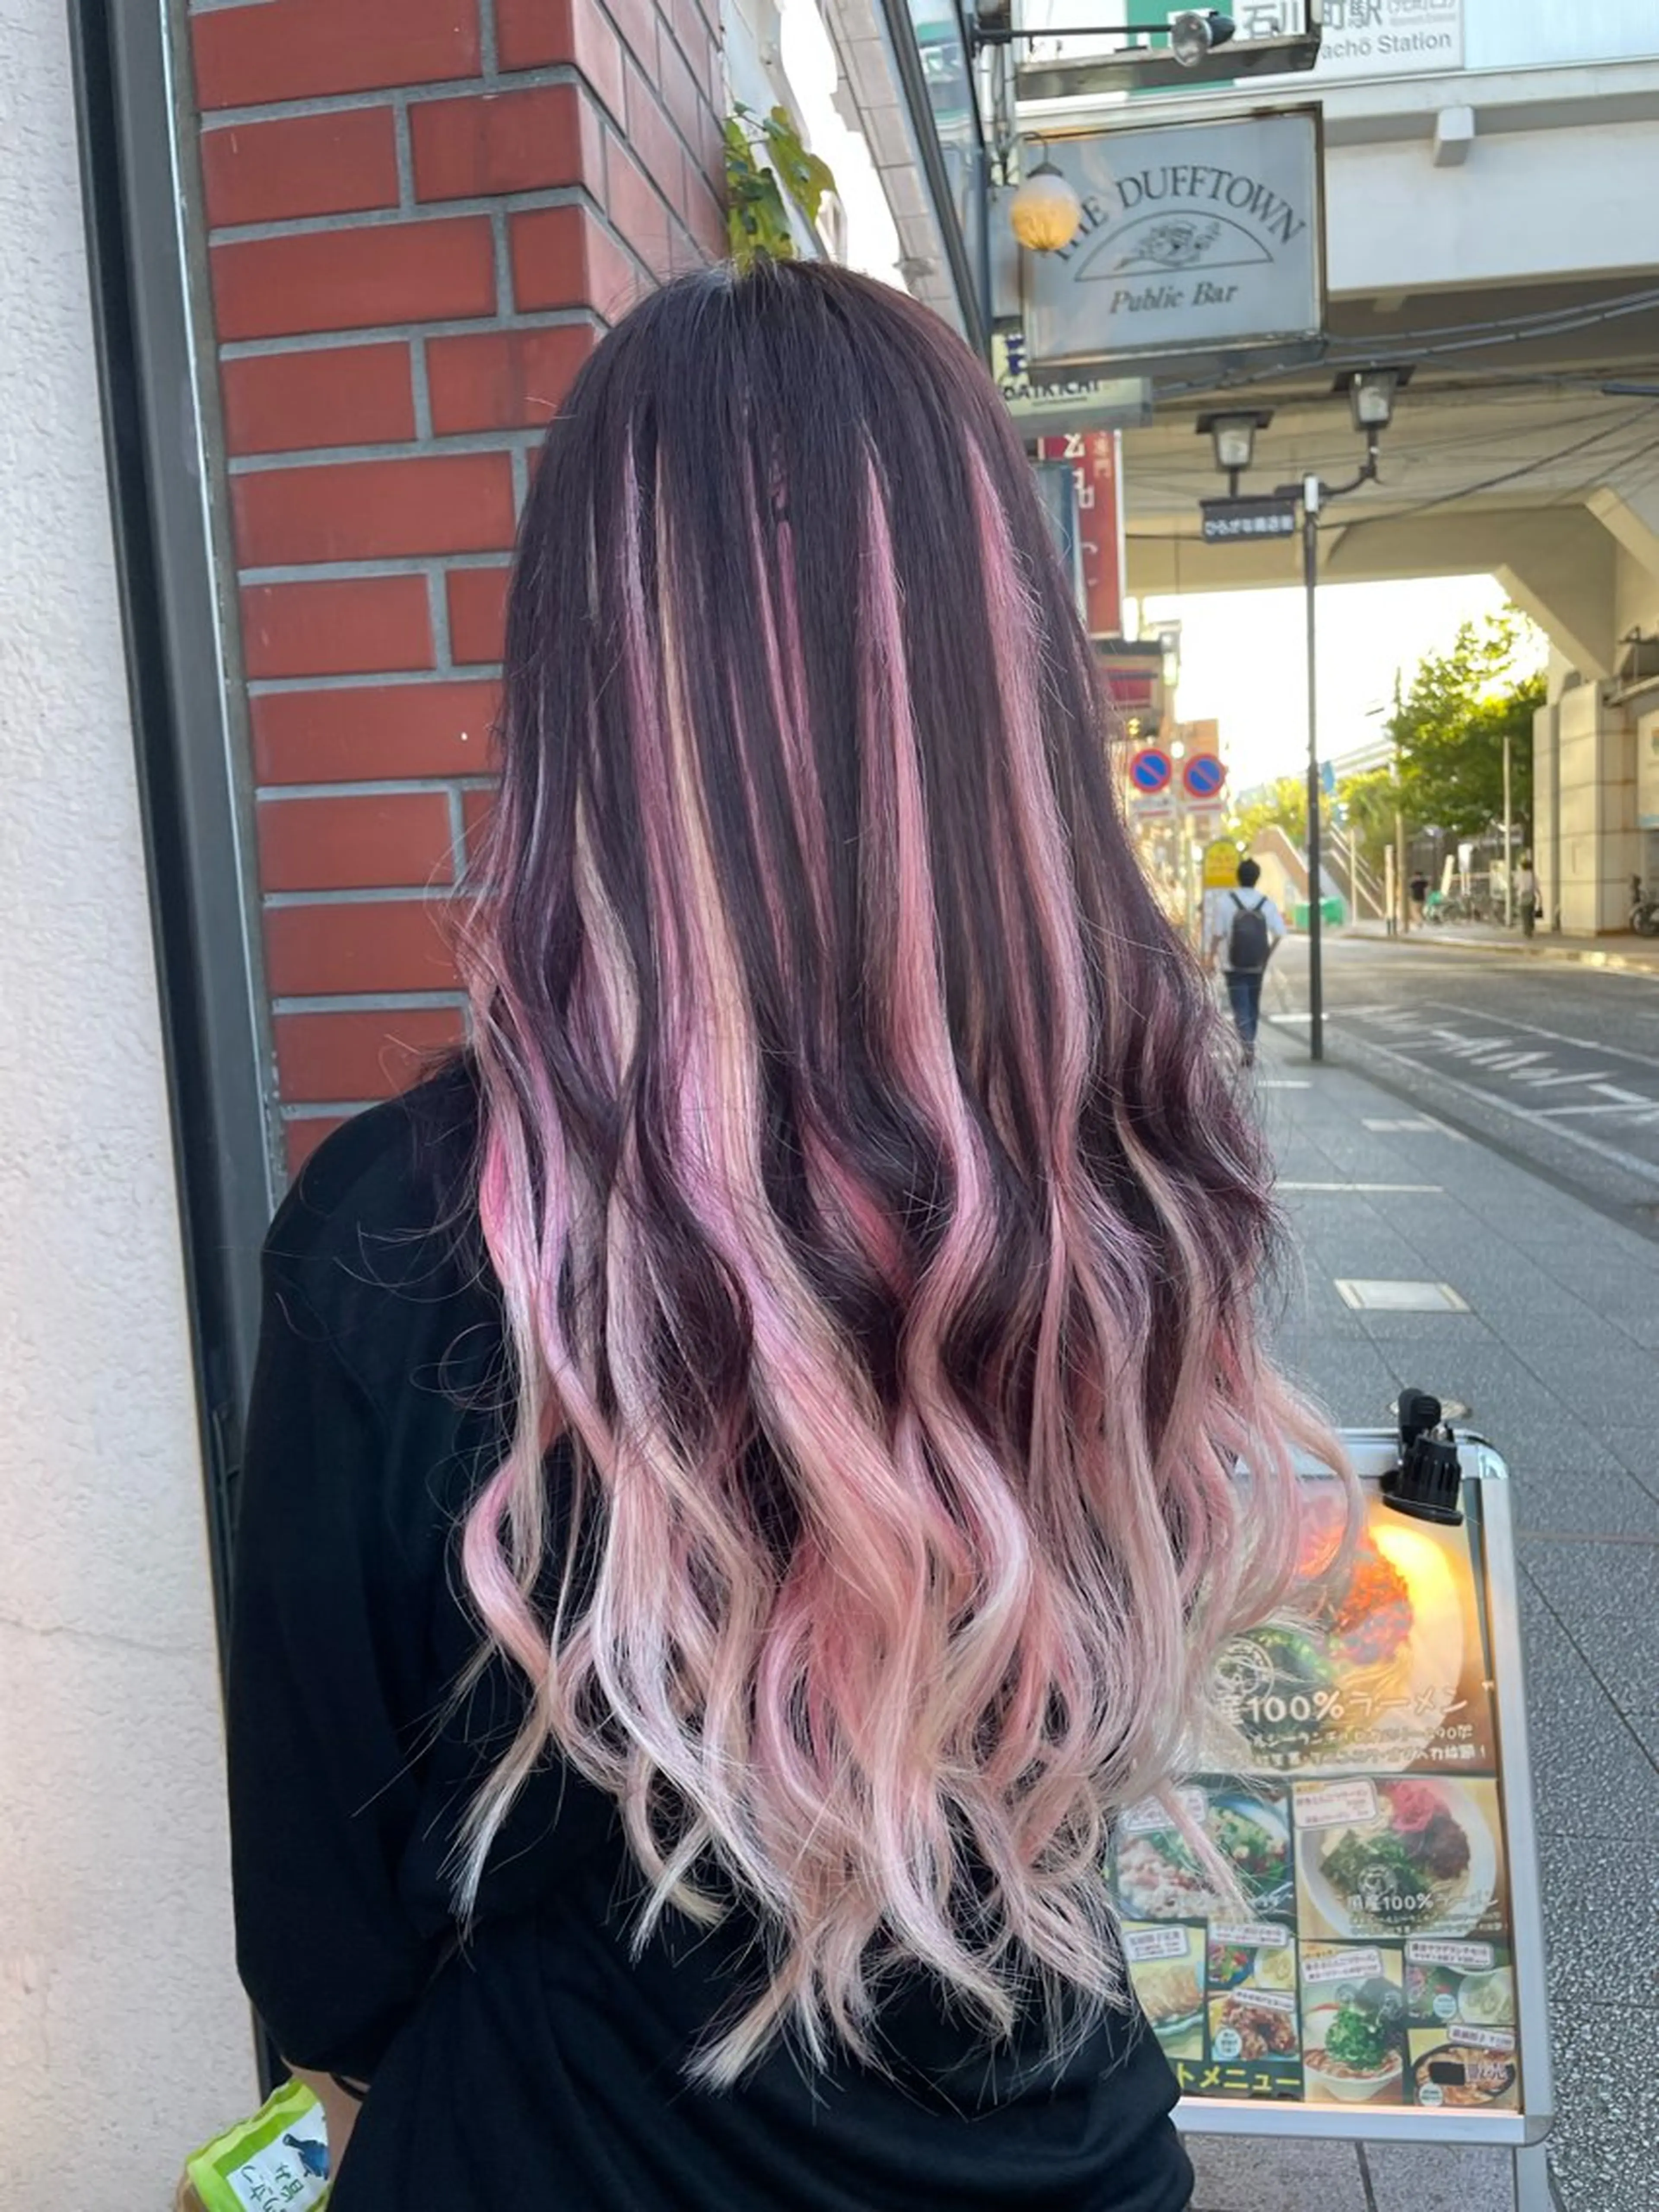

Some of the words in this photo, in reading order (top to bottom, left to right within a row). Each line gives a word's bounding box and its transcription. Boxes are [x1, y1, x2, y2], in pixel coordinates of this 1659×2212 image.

[1322, 41, 1372, 59] achō
[1377, 31, 1452, 54] Station
[1116, 165, 1306, 245] DUFFTOWN
[1110, 287, 1185, 314] Public
[1193, 281, 1239, 305] Bar
[1216, 1689, 1468, 1725] 産100%ラーメン
[1176, 2062, 1301, 2091] トメニュー
